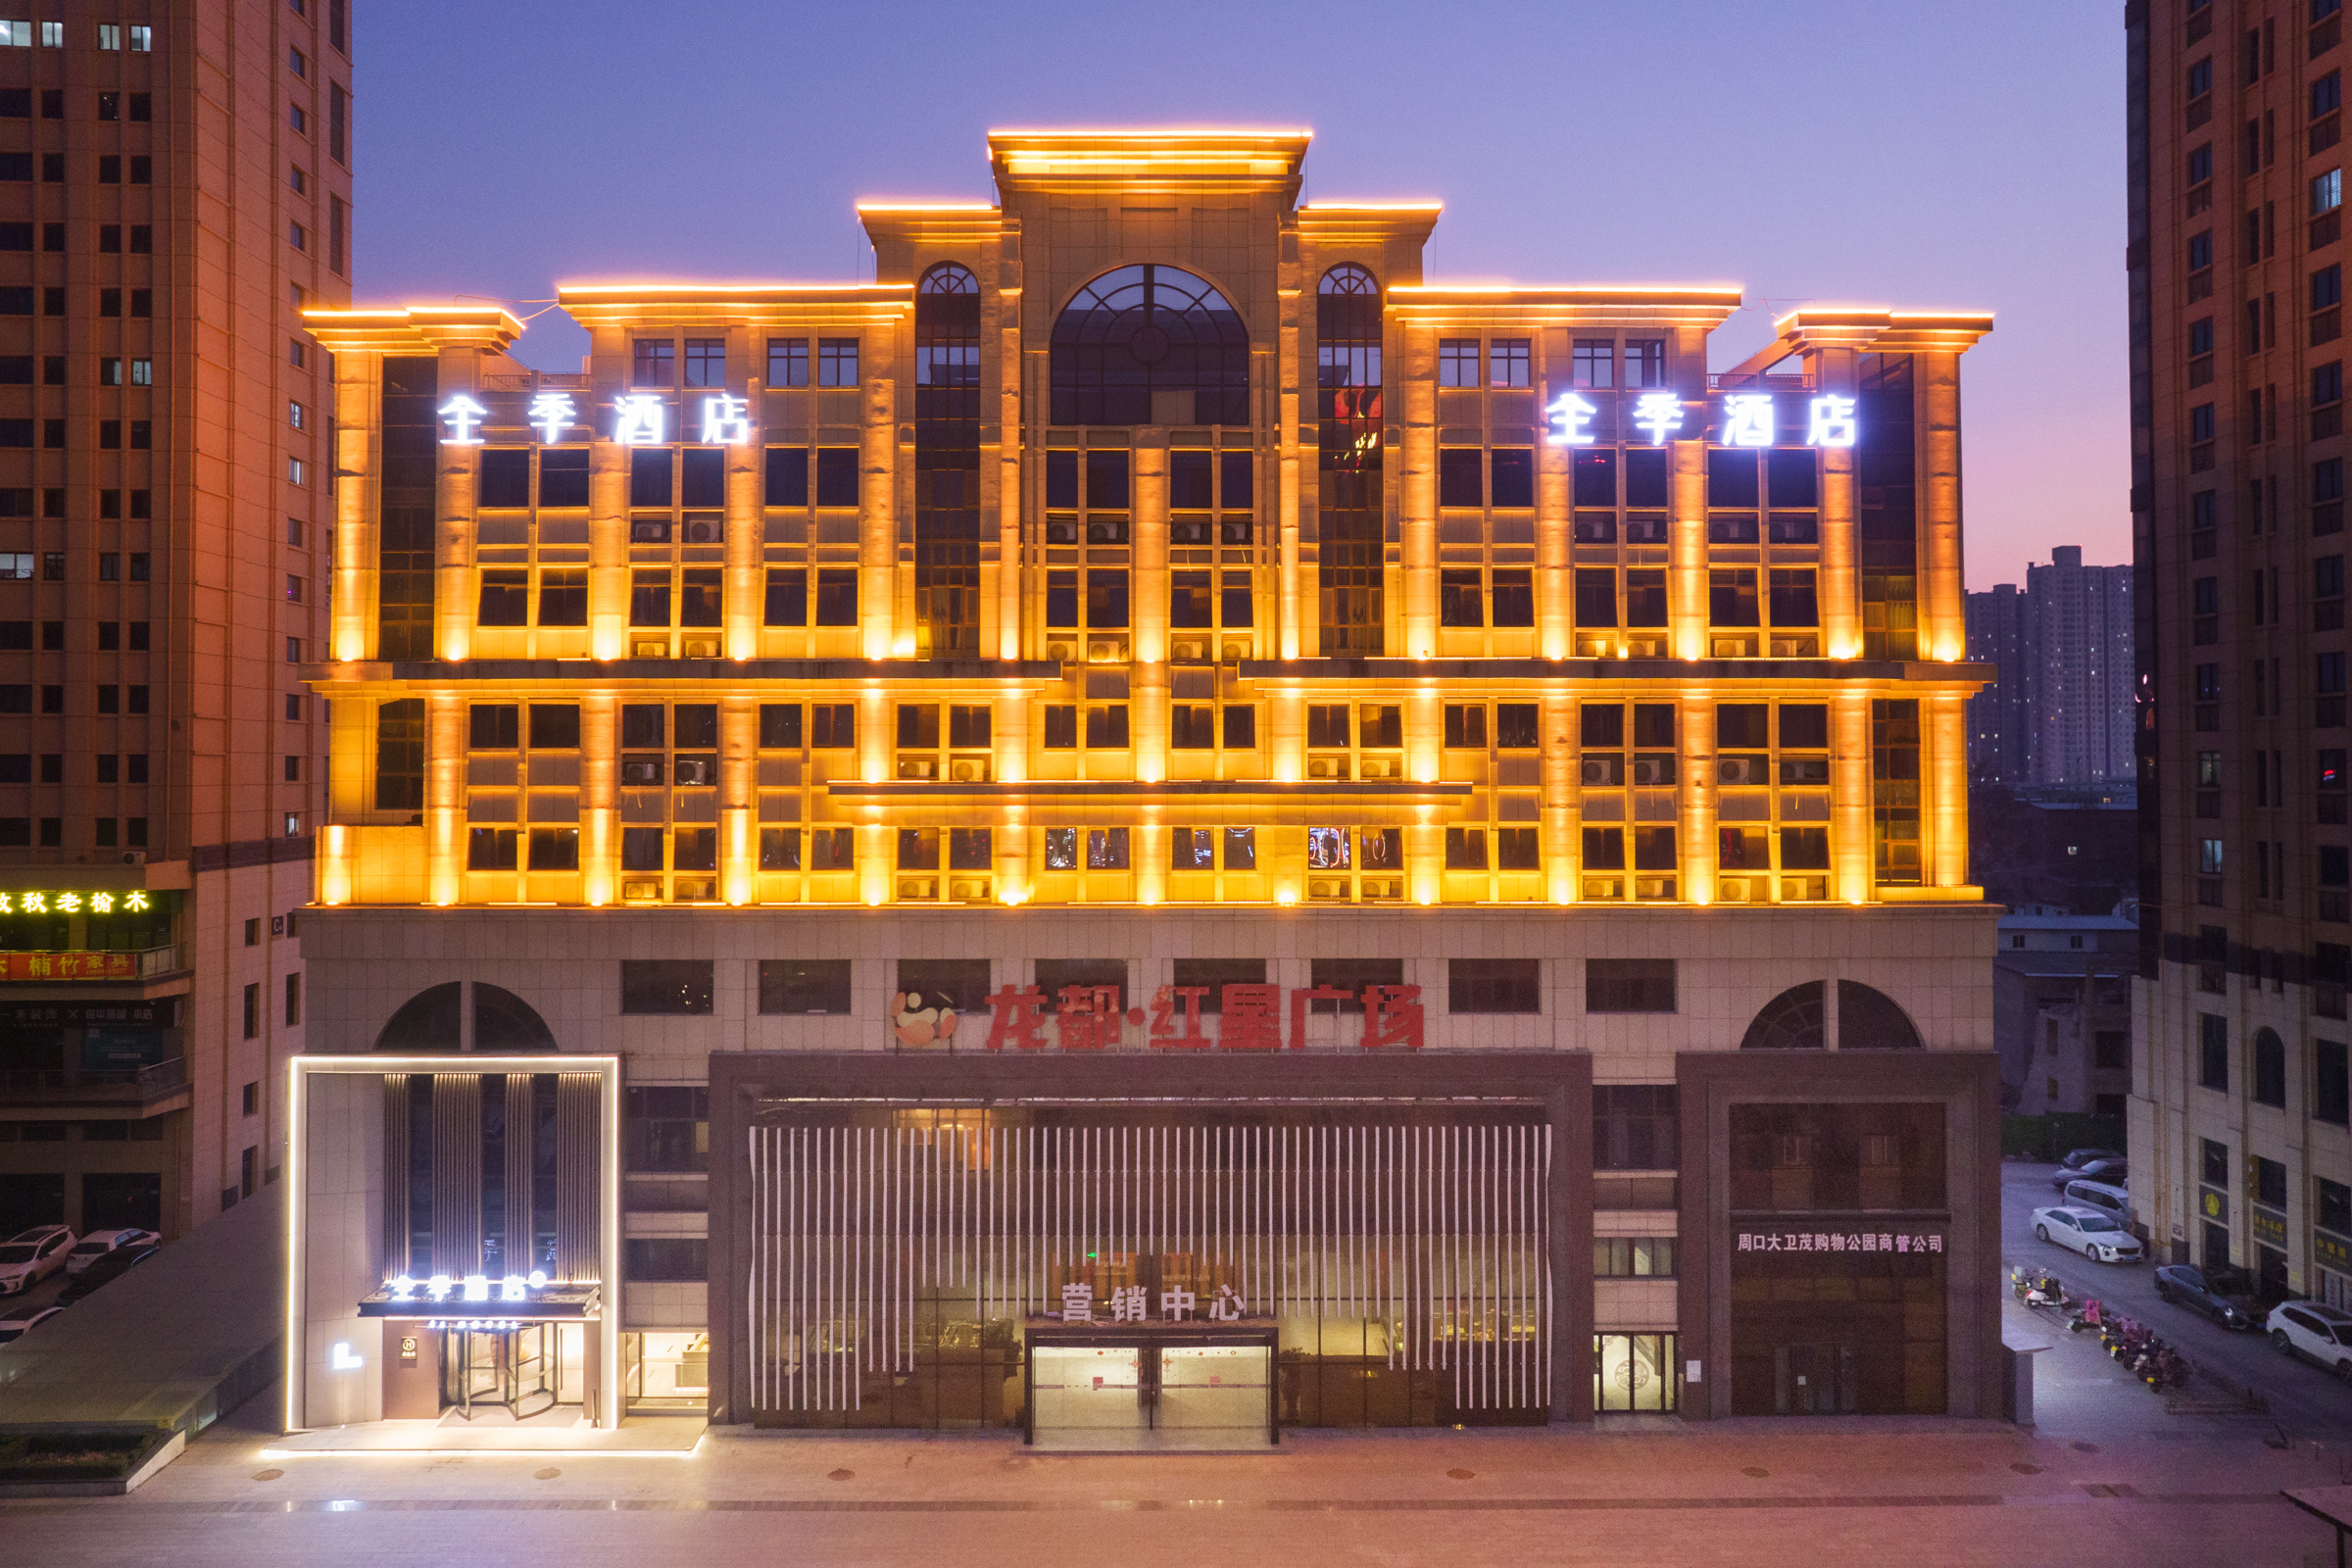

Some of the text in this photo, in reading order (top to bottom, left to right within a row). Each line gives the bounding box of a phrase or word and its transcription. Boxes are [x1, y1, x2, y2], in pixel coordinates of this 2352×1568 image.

[437, 393, 750, 445] 全季酒店
[1544, 392, 1856, 447] 全季酒店
[1738, 1233, 1943, 1253] 周口大卫茂购物公园商管公司
[1062, 1282, 1246, 1322] 营销中心
